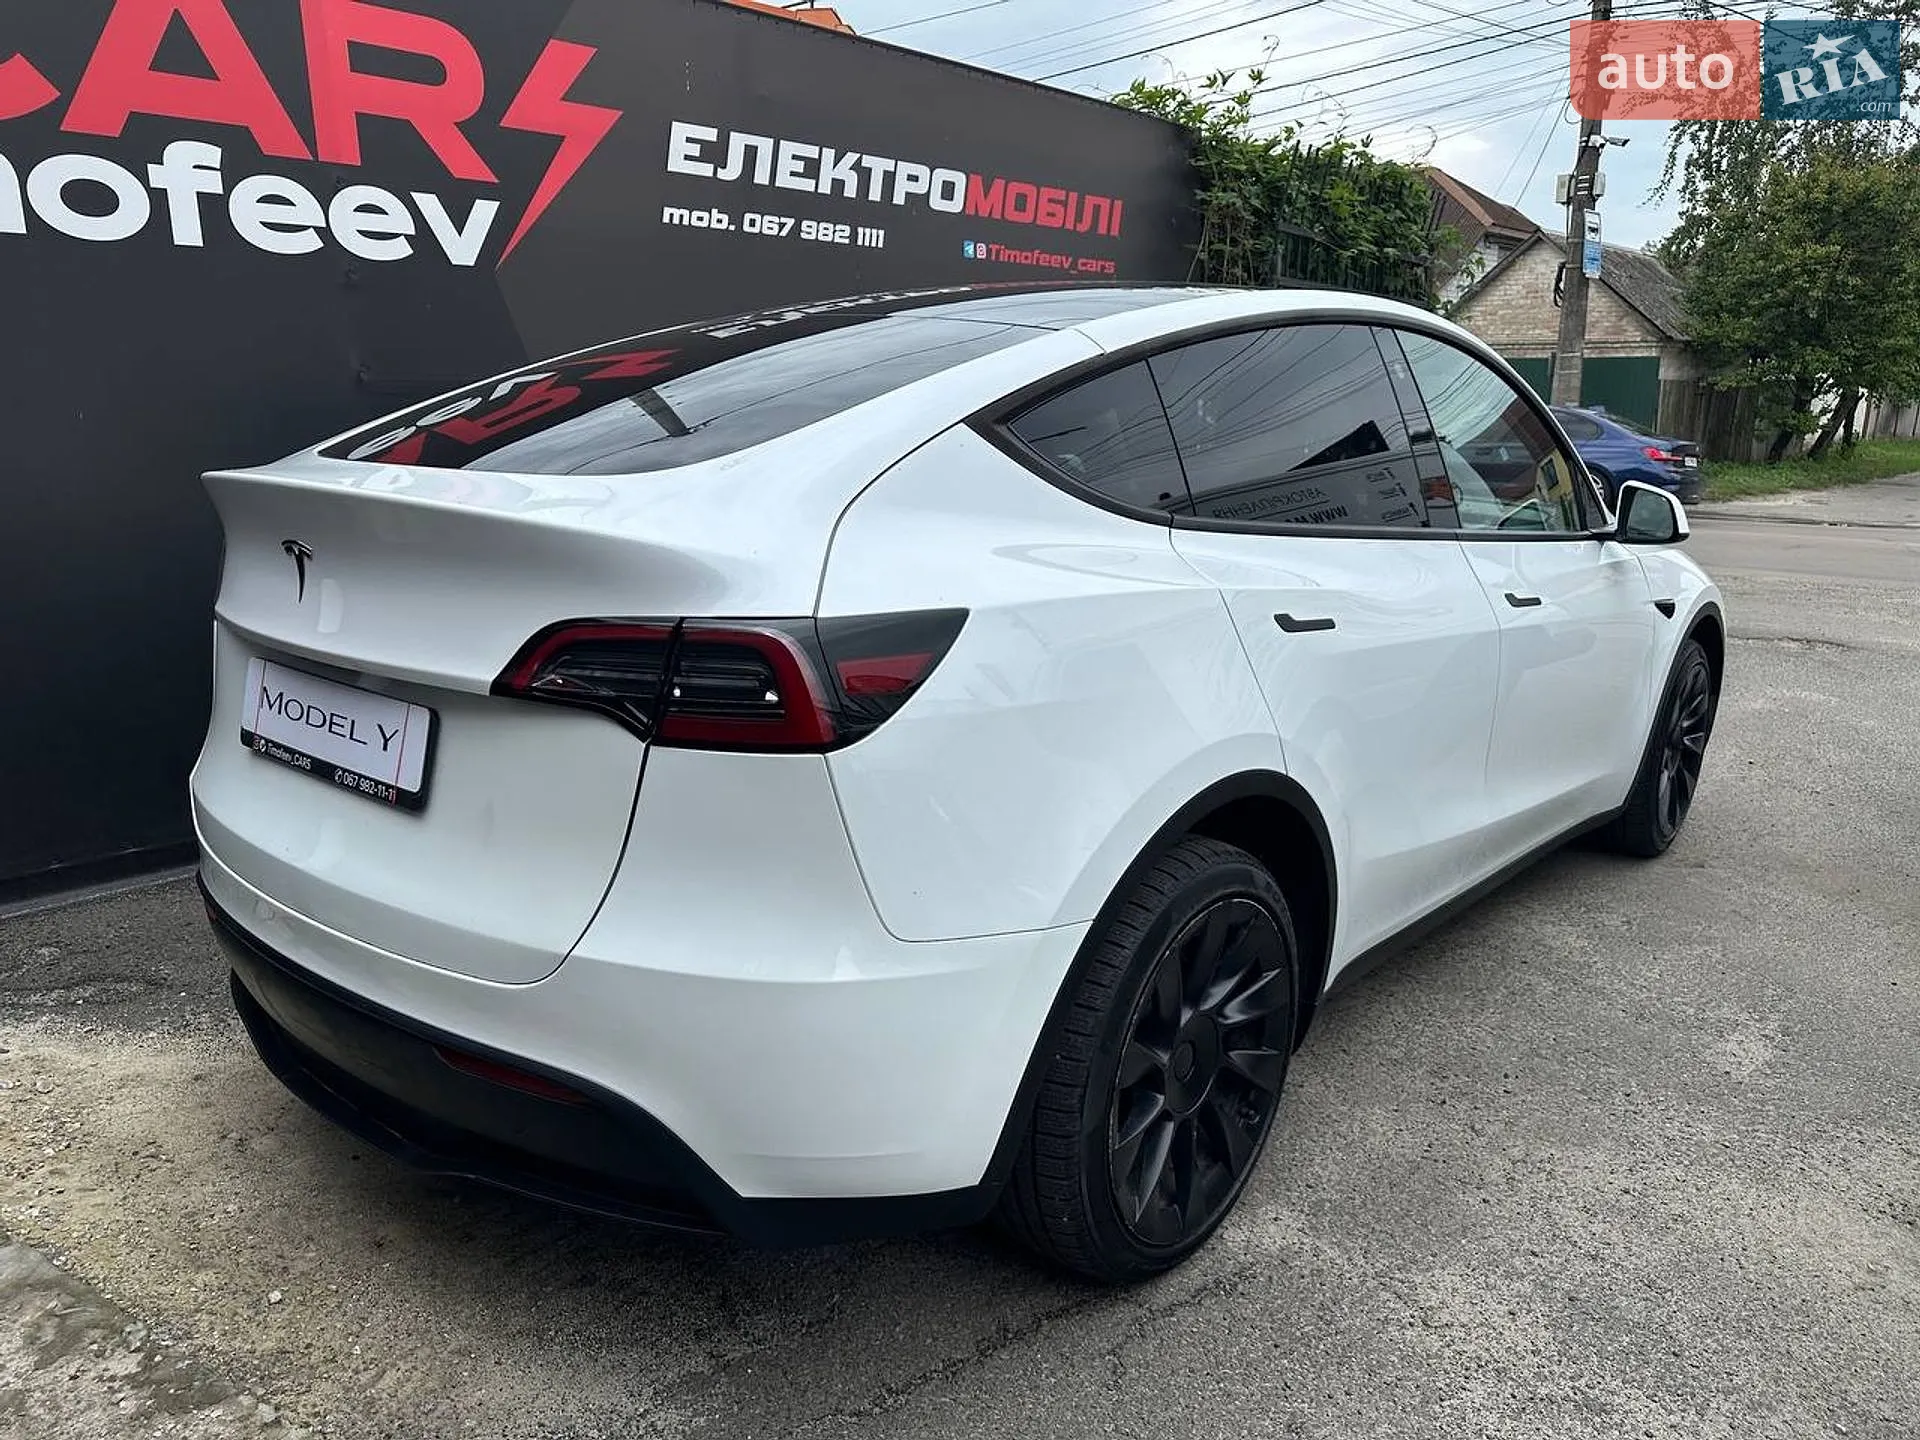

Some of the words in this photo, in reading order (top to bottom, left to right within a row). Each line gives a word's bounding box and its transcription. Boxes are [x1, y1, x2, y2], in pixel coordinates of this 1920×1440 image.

[666, 121, 1123, 239] ЕЛЕКТРОМОБІЛІ
[662, 205, 735, 231] mob.
[742, 211, 796, 238] 067
[800, 220, 851, 246] 982
[855, 226, 885, 248] 1111
[988, 243, 1116, 275] Timofeev_cars
[260, 685, 367, 745] MODEL
[376, 722, 399, 752] Y
[343, 772, 358, 788] 067
[359, 778, 397, 801] 982-11-11
